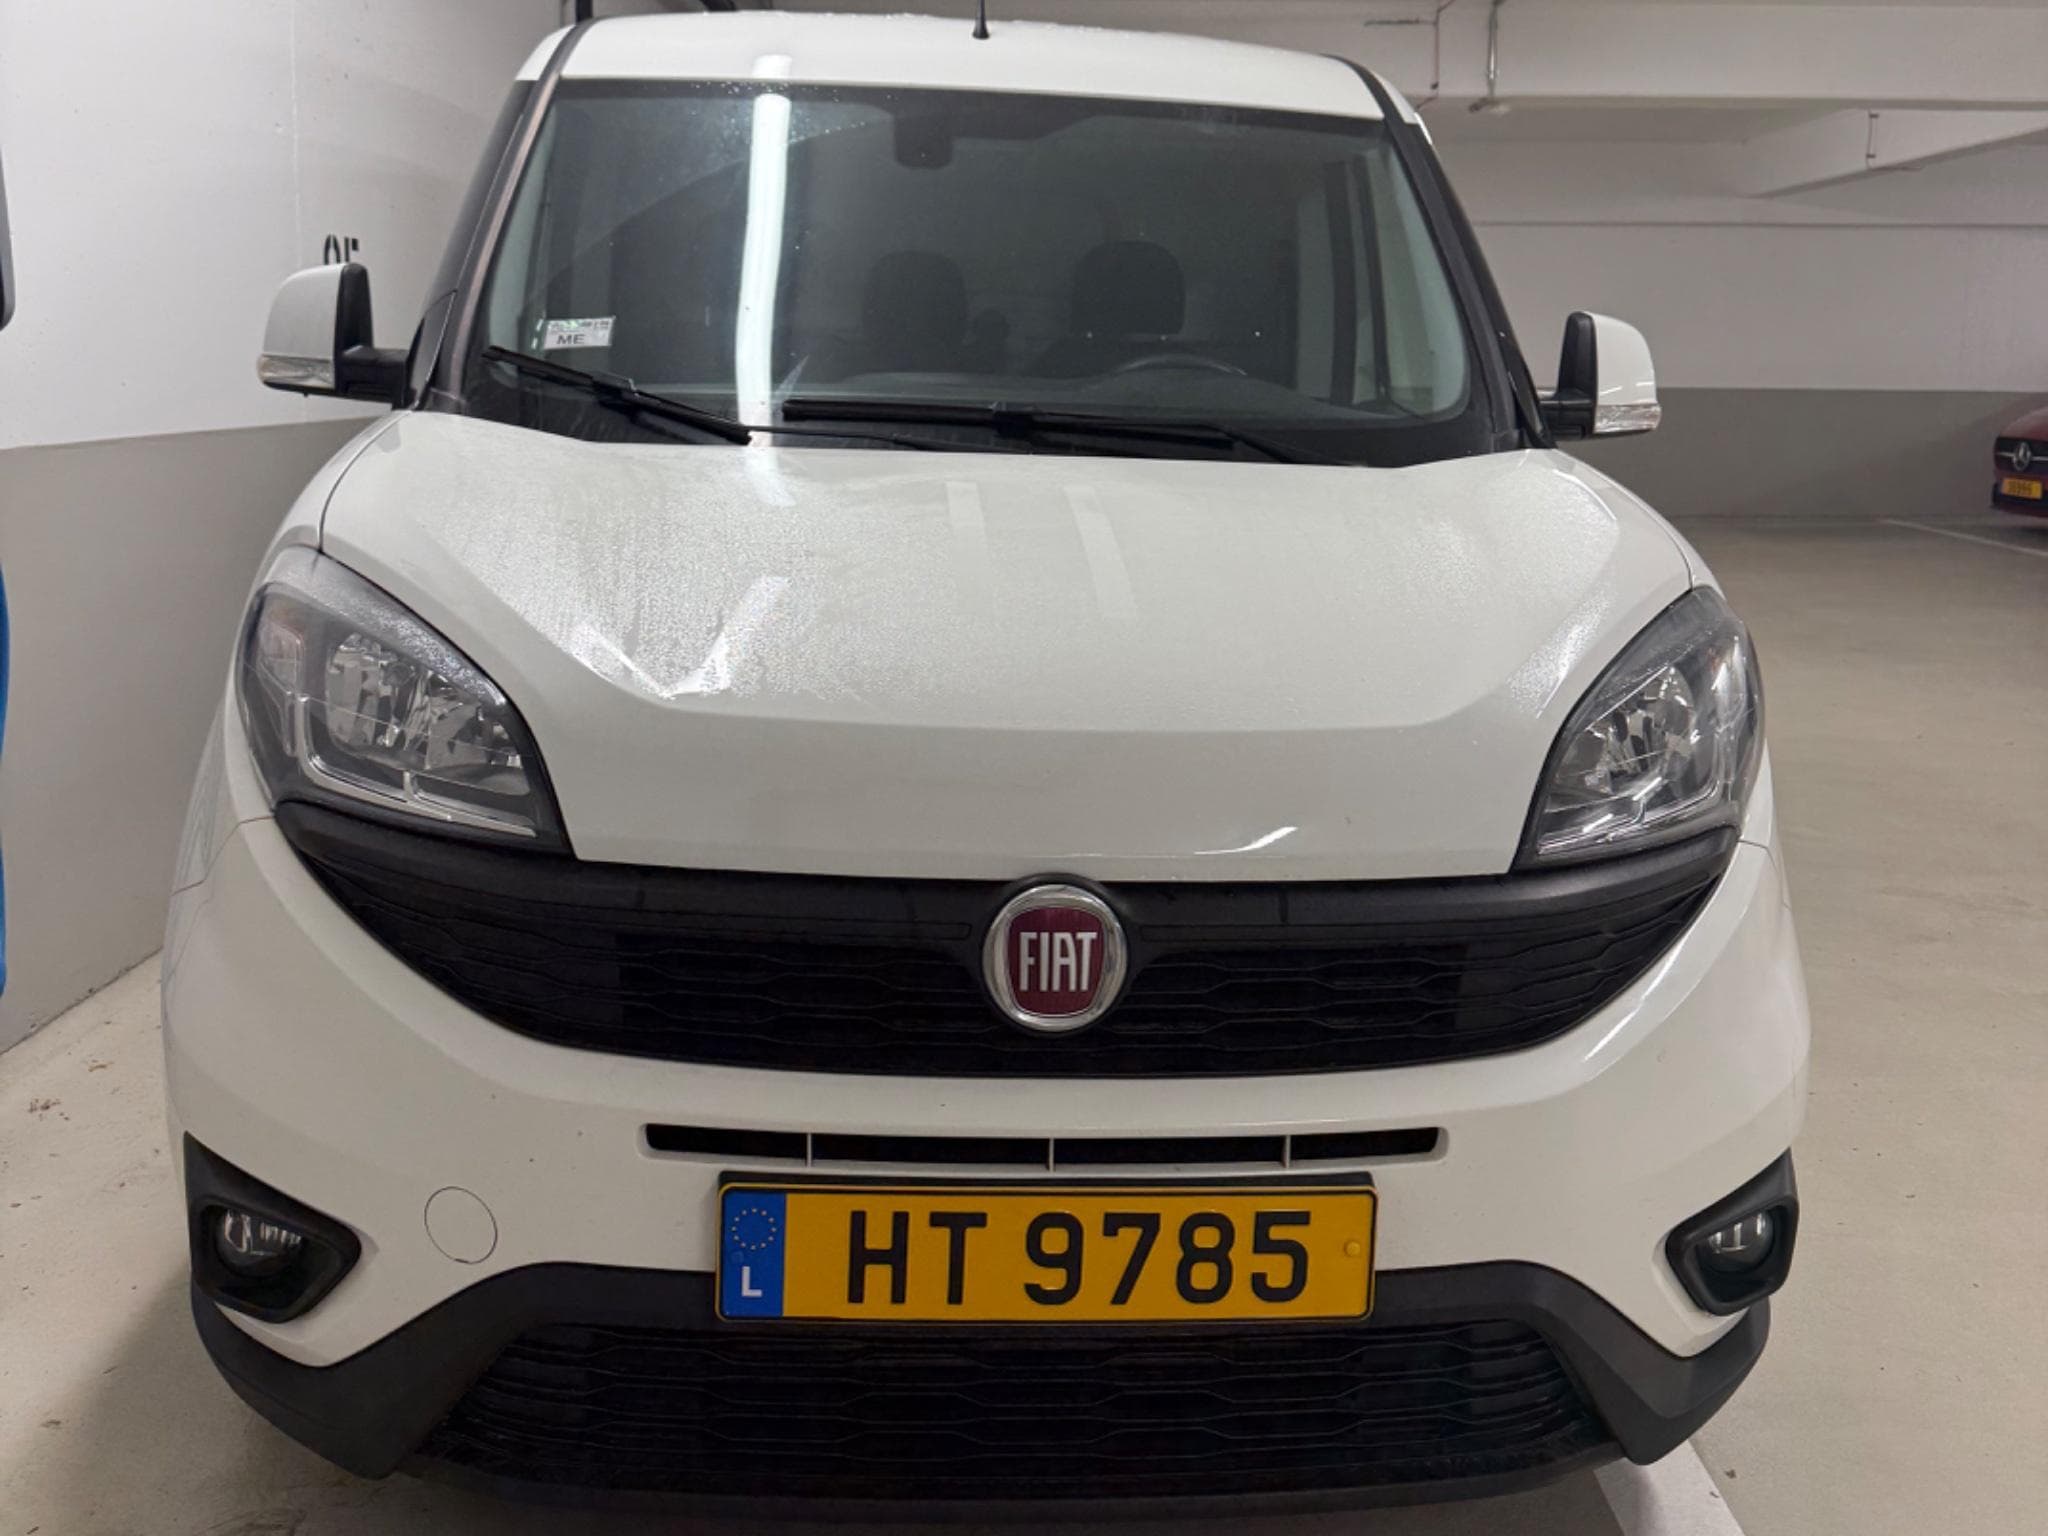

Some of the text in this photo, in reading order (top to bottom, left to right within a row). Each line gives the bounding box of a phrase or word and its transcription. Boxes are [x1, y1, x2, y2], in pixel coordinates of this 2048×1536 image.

[557, 334, 585, 345] ME
[1019, 931, 1098, 993] FIAT
[847, 1211, 1310, 1305] HT 9785
[742, 1266, 762, 1297] L
